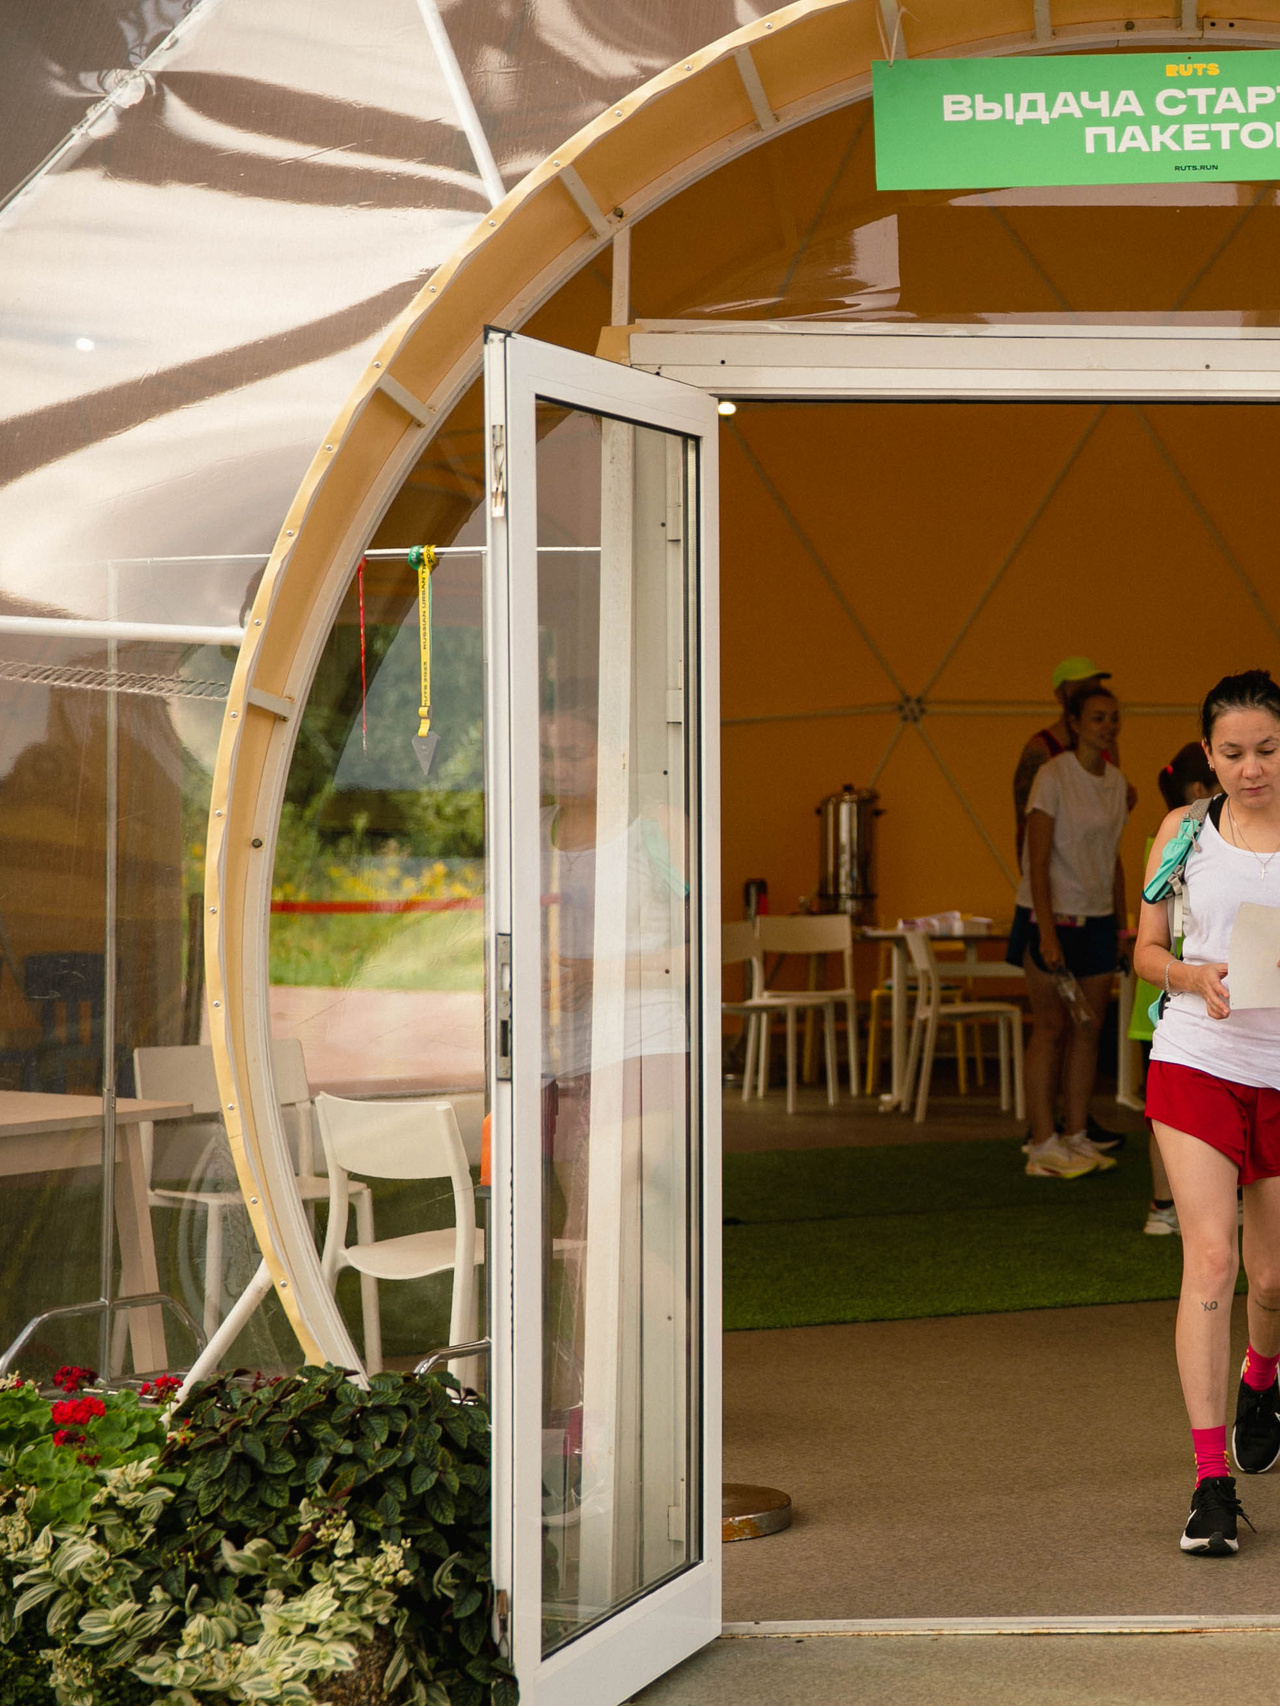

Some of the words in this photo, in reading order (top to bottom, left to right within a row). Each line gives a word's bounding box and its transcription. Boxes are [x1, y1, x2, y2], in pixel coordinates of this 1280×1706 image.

[1165, 63, 1220, 77] RUTS
[943, 90, 1145, 125] ВЫДАЧА
[1174, 164, 1219, 172] RUTS.RUN
